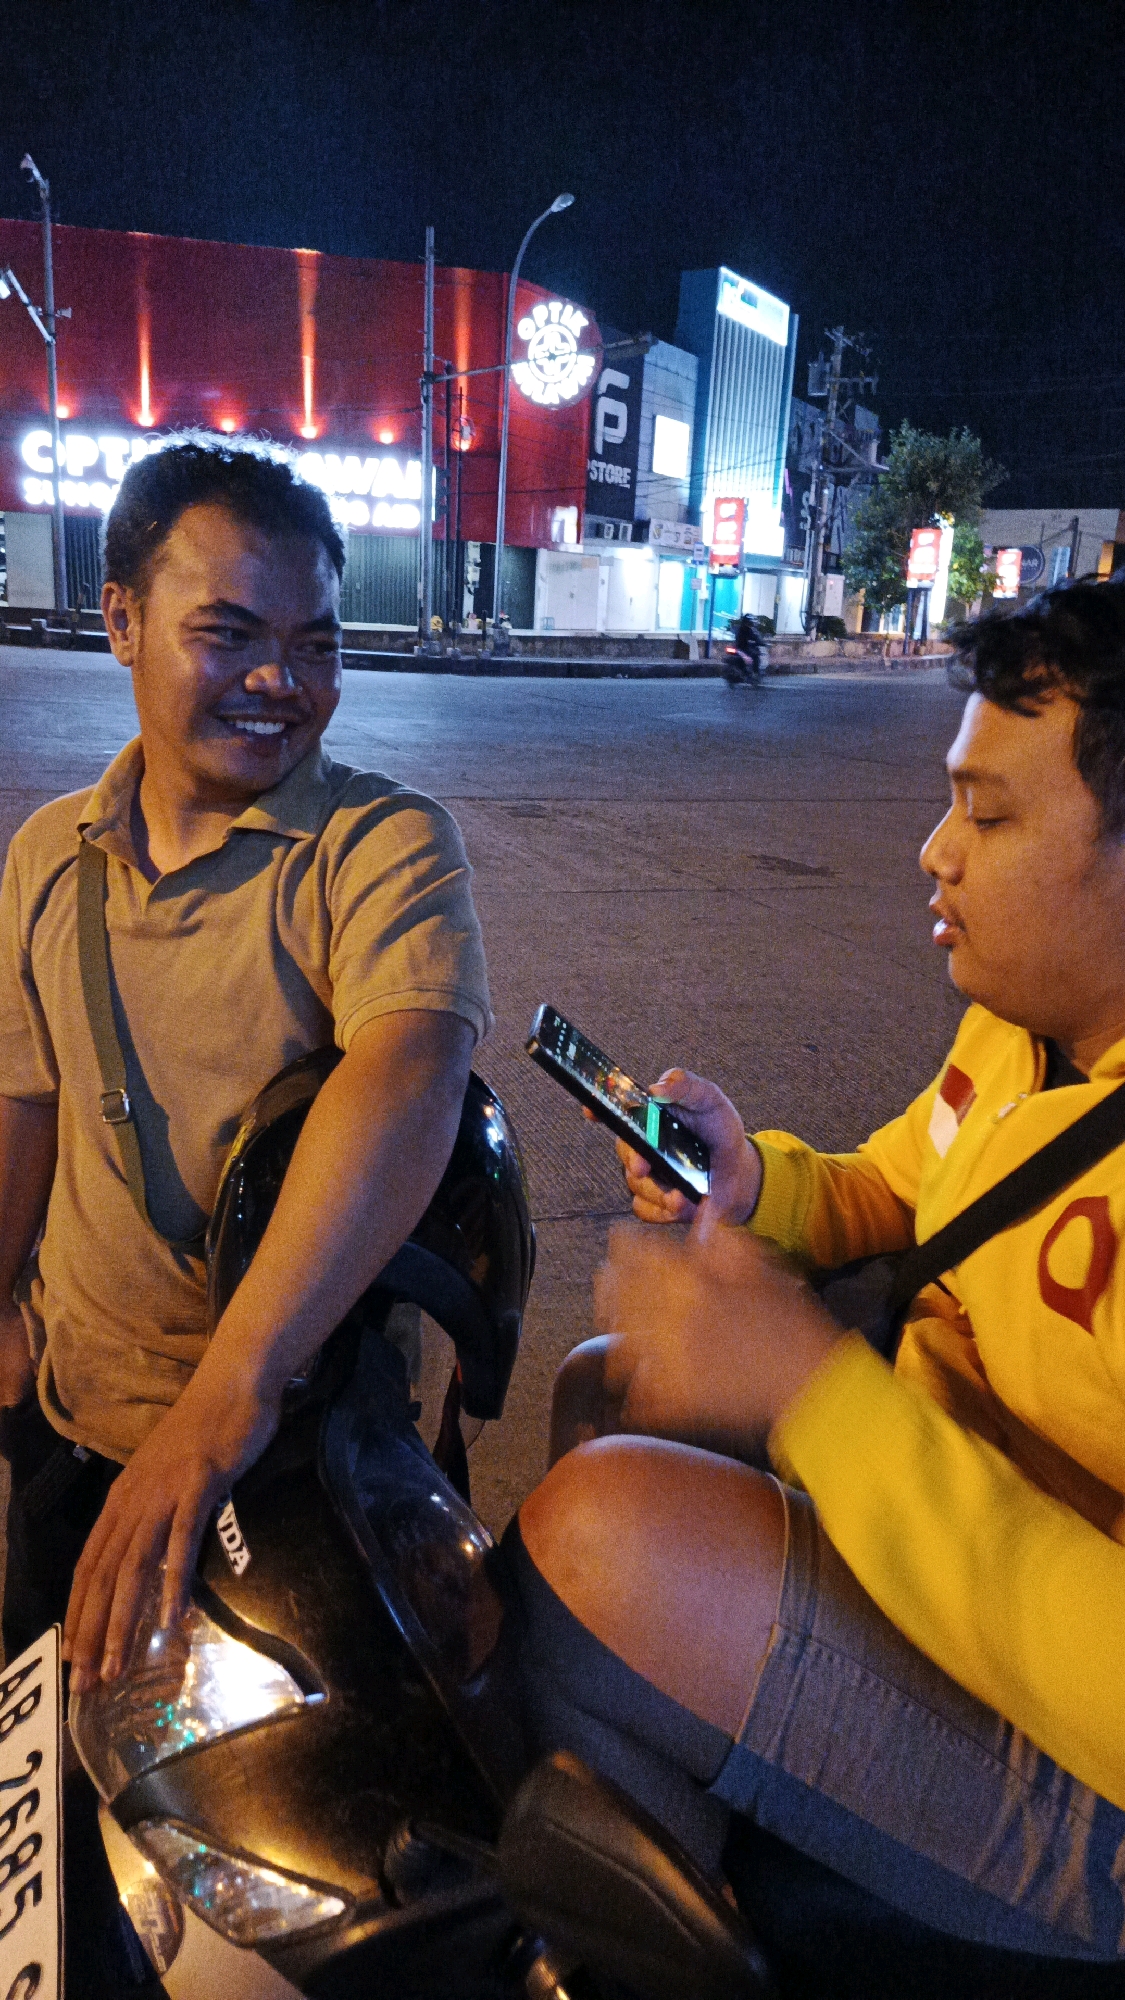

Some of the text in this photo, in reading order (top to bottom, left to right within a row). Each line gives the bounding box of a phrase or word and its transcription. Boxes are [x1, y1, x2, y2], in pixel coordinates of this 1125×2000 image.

[517, 301, 589, 340] OPTIK
[217, 1501, 252, 1575] NDA
[0, 1656, 43, 1743] AB
[0, 1749, 43, 1940] 2685
